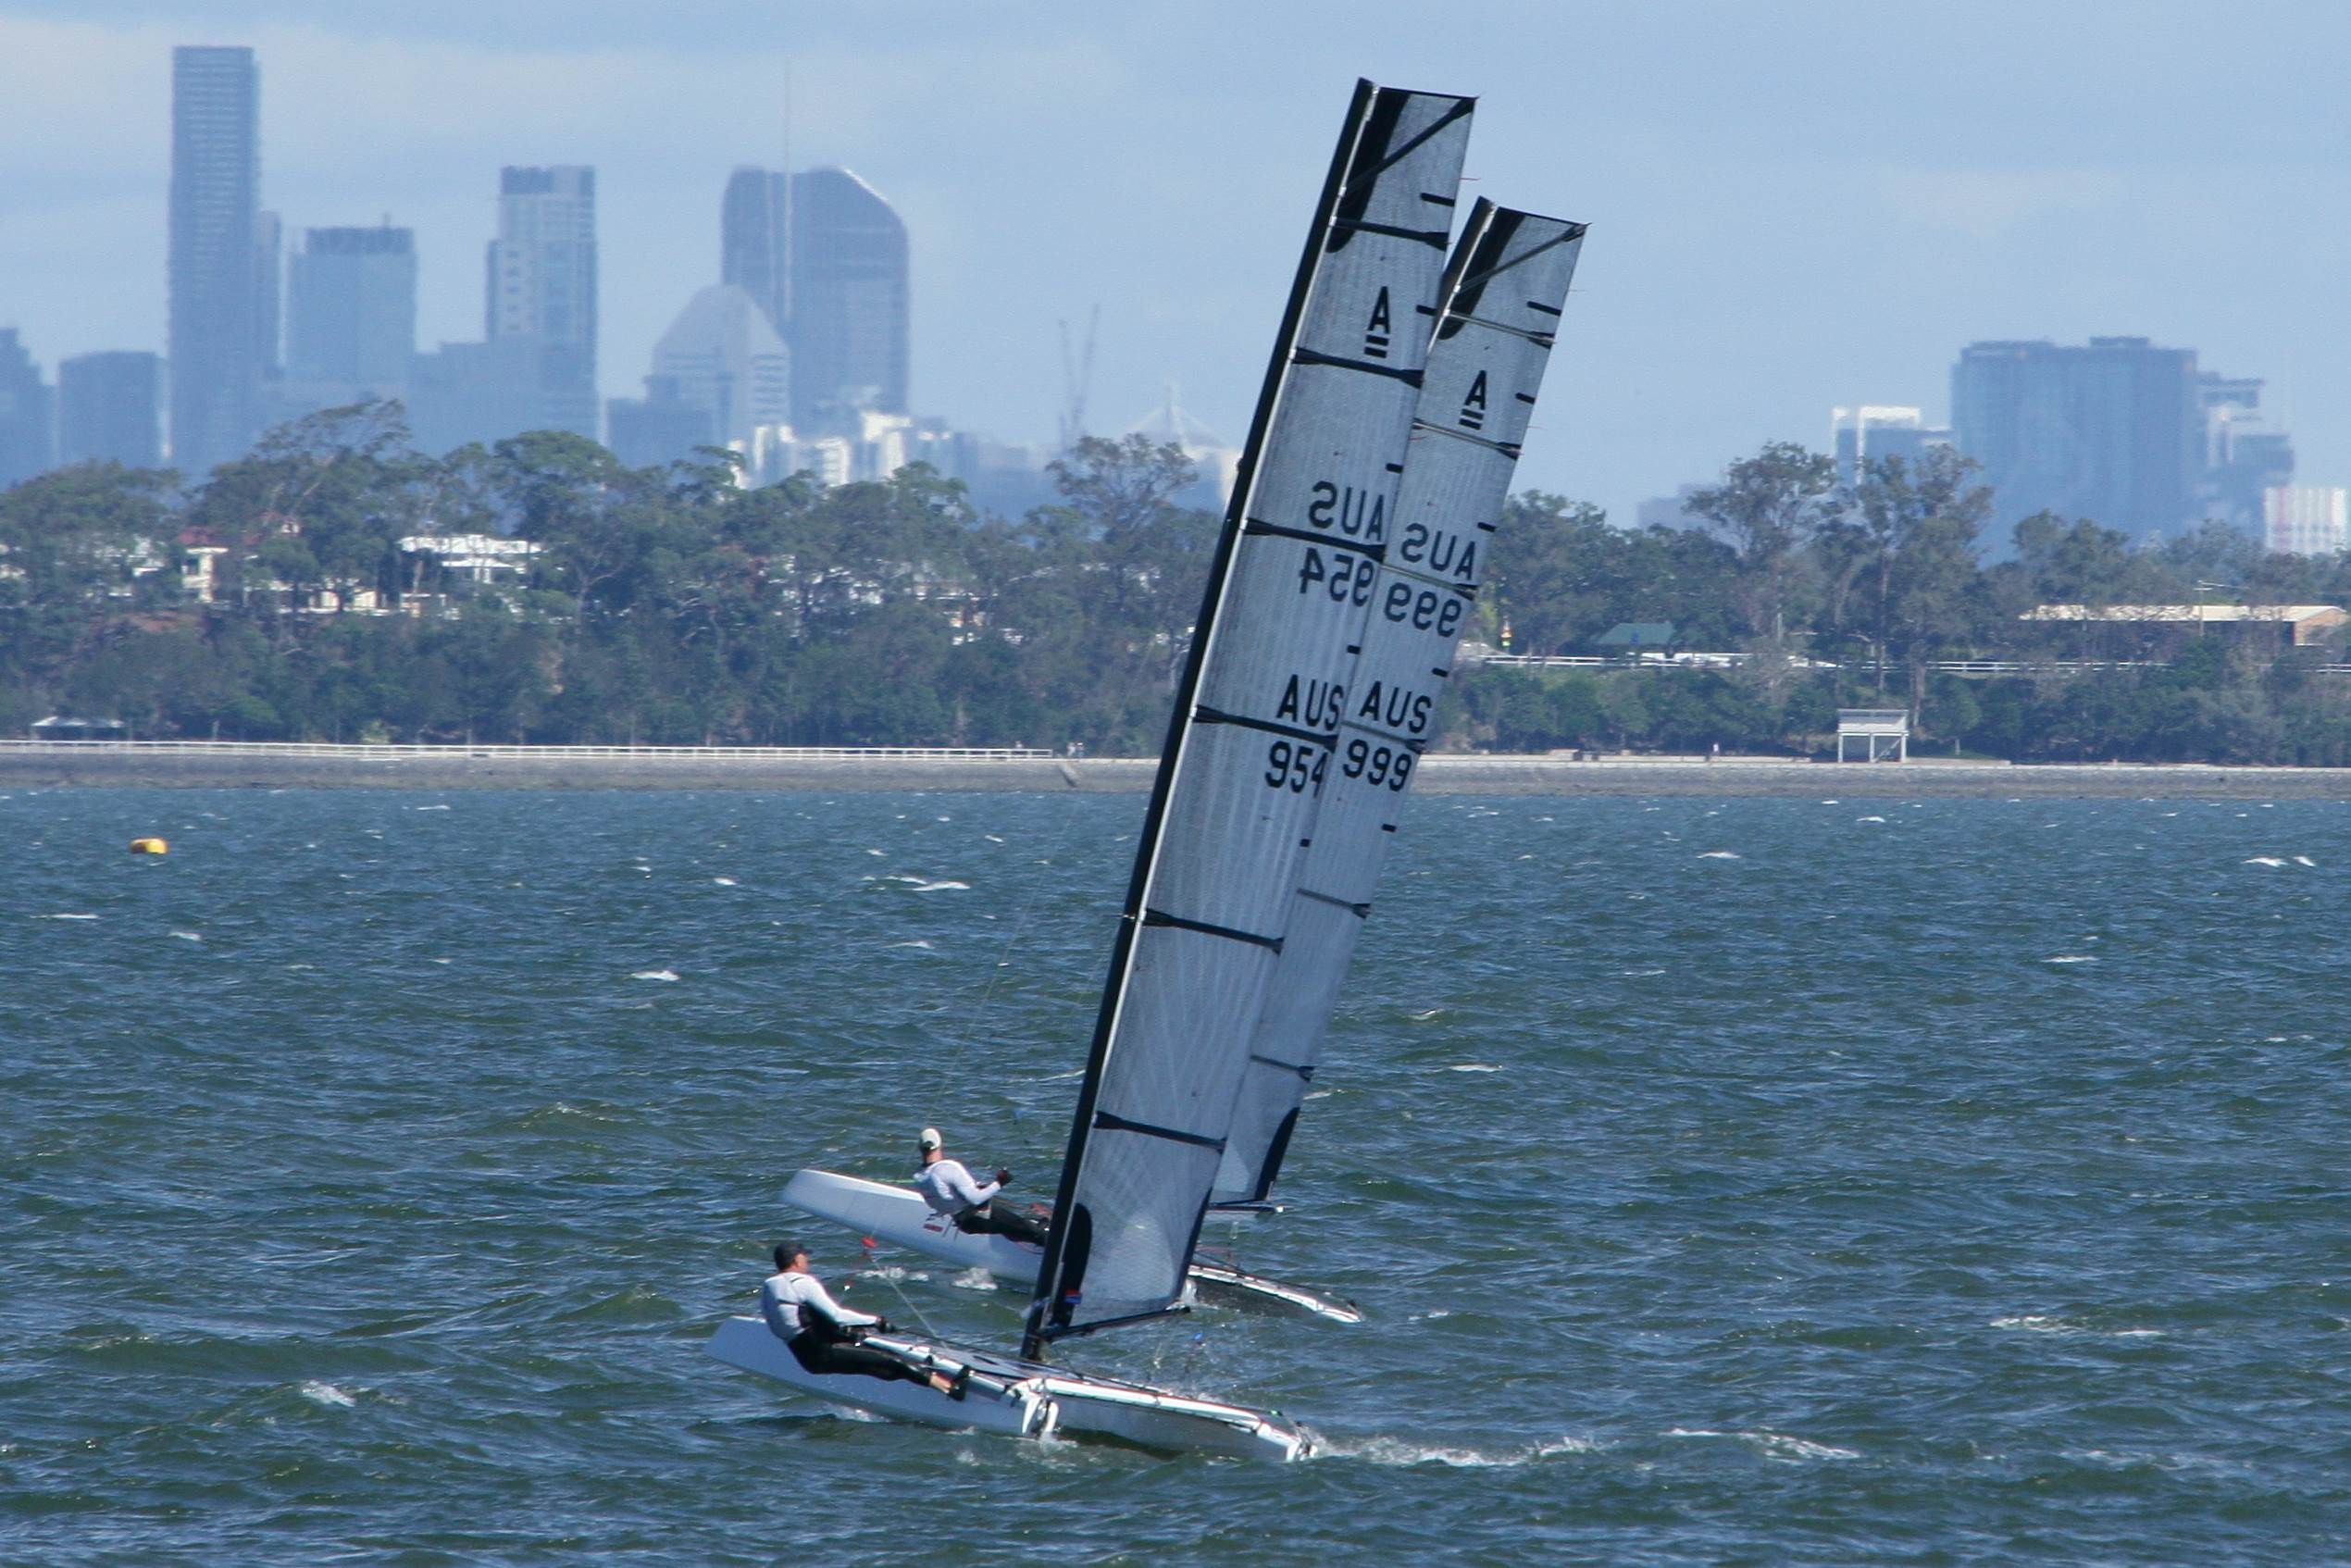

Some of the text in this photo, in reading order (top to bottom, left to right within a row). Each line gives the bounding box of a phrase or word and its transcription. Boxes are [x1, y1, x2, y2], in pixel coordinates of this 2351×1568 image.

[1367, 286, 1390, 334] A
[1464, 370, 1486, 410] A
[1276, 674, 1344, 731] AUS
[1359, 681, 1432, 733] AUS
[1264, 740, 1328, 798] 954
[1342, 739, 1412, 791] 999
